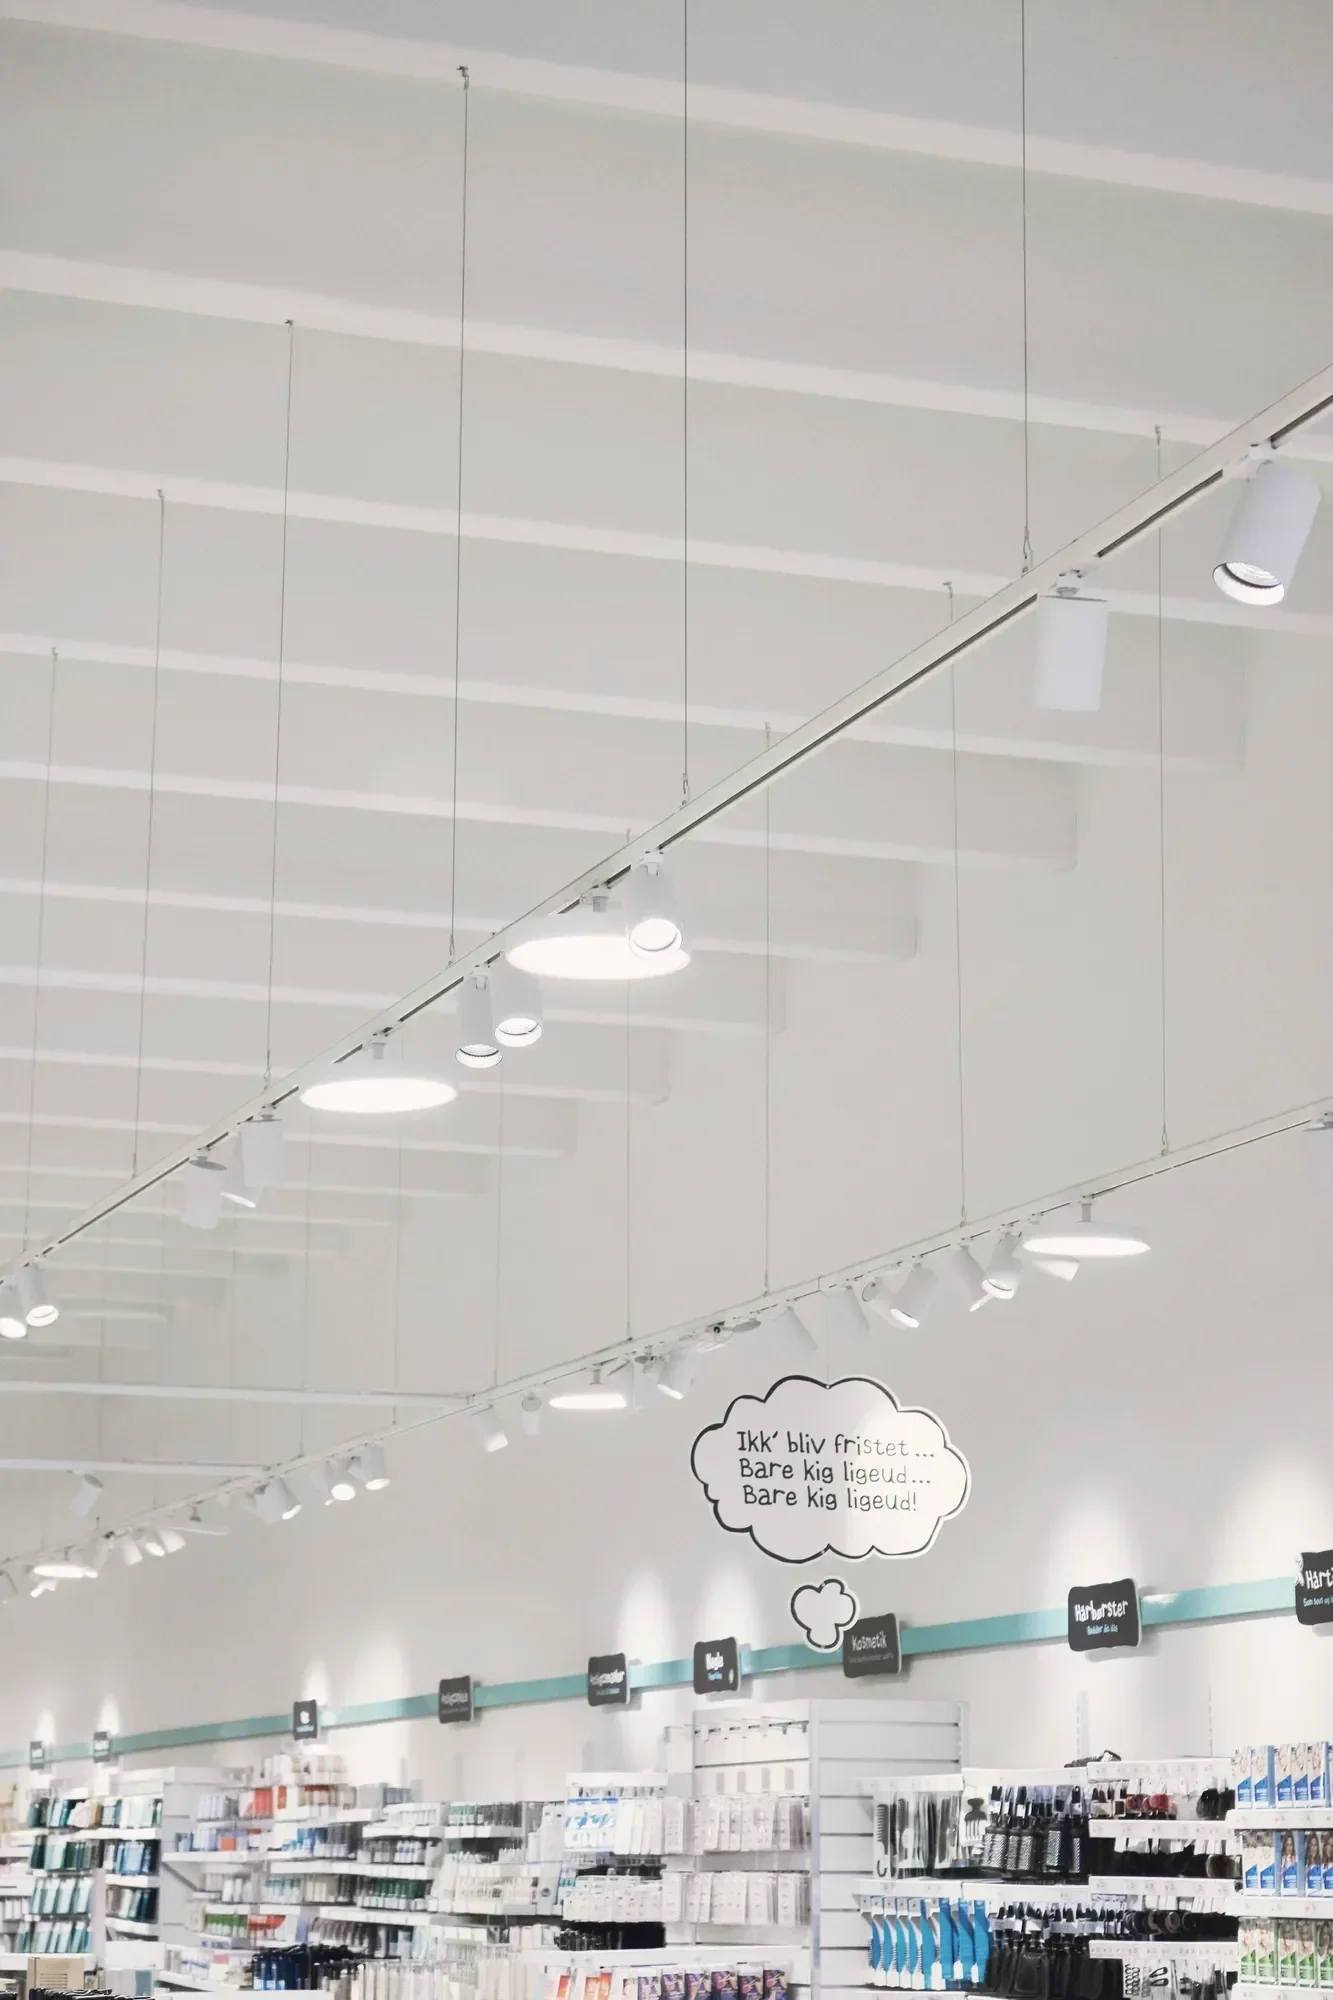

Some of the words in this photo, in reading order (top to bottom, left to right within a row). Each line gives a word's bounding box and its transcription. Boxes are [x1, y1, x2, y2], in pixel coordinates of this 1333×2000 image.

[787, 1431, 826, 1454] bliv
[739, 1458, 794, 1479] Bare
[804, 1459, 834, 1484] kig
[843, 1461, 931, 1485] ligeud...
[743, 1485, 798, 1506] Bare
[807, 1485, 838, 1511] kig
[847, 1488, 917, 1512] ligeud!
[851, 1630, 888, 1652] Kosmetik
